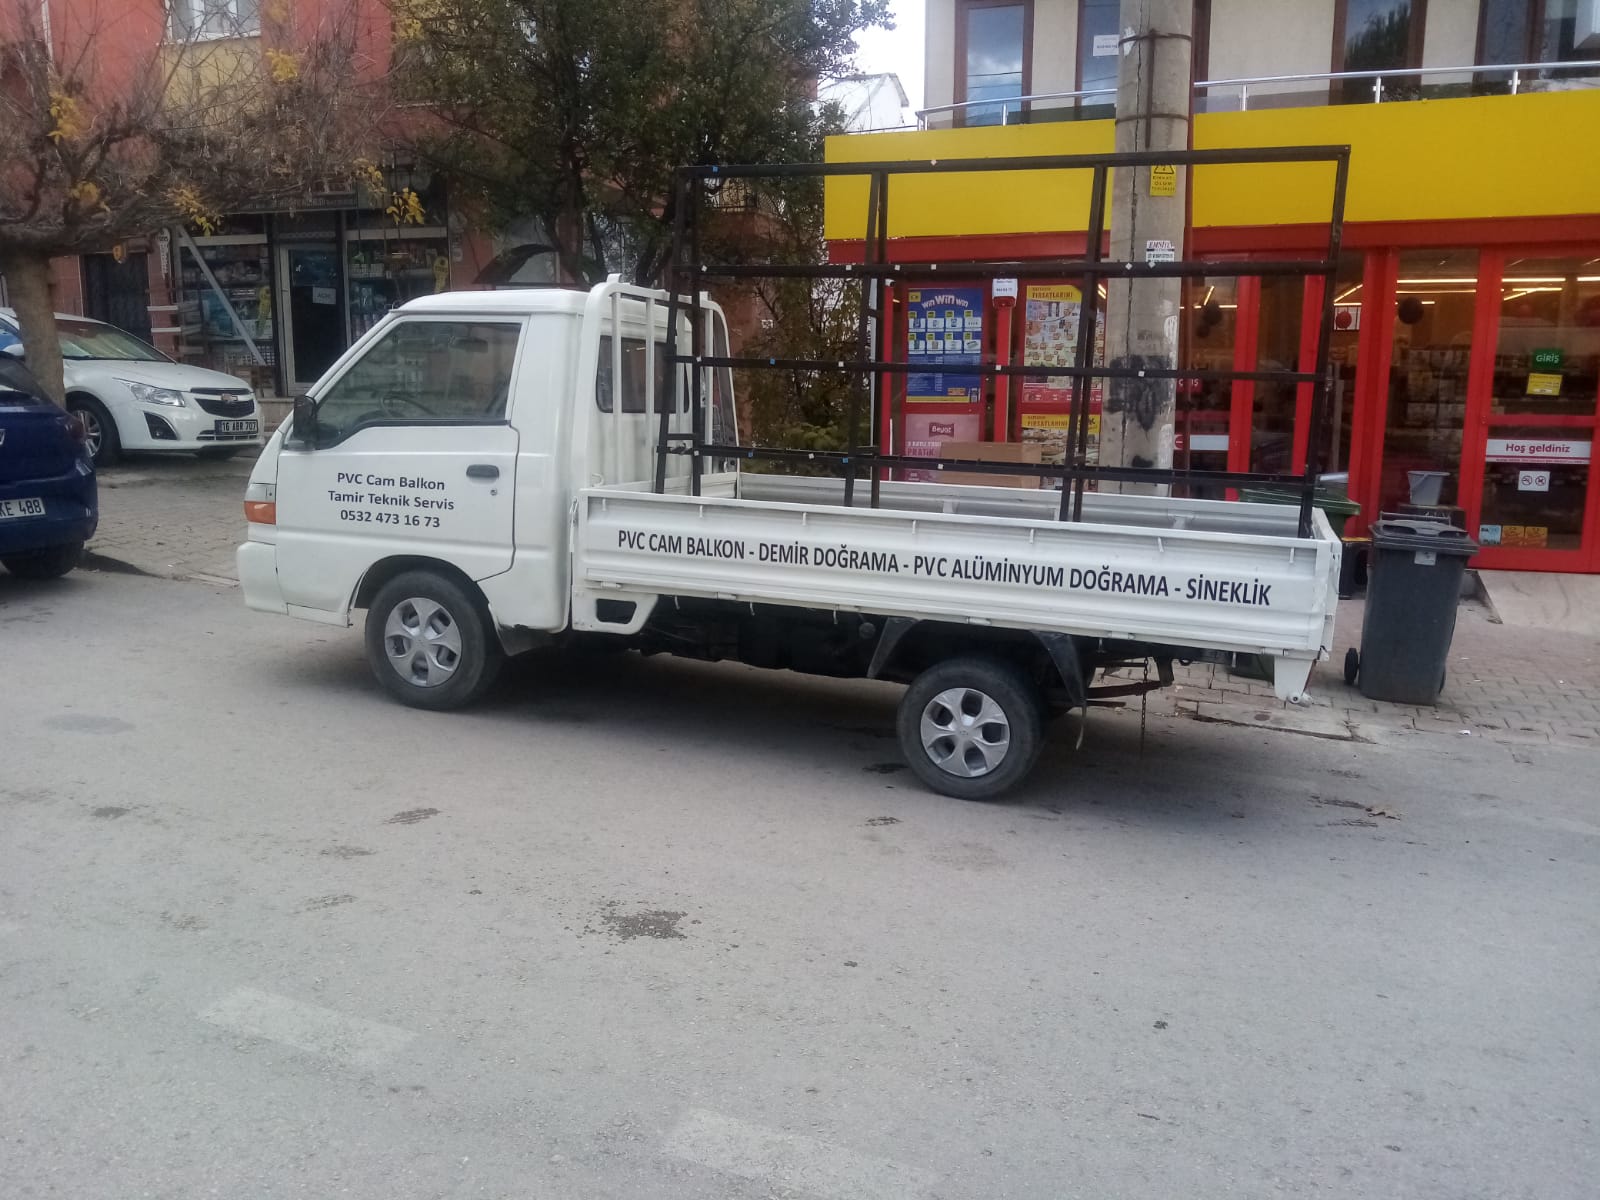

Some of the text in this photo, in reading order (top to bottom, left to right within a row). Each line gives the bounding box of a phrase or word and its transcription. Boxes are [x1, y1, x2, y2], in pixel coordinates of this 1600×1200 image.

[1535, 353, 1560, 363] GİRİŞ
[1505, 443, 1571, 455] Hoş geldiniz
[337, 472, 445, 491] PVC Cam Balkon
[18, 499, 42, 515] 488
[328, 490, 455, 511] Tamir Teknik Servis
[340, 509, 440, 528] 0532 473 16 73
[618, 530, 646, 550] PVC
[649, 533, 682, 555] CAM
[686, 537, 745, 560] BALKON
[758, 541, 809, 566] DEMİR
[813, 543, 899, 574] DOĞRAMA
[914, 555, 947, 578] PVC
[951, 556, 1065, 588] ALÜMİNYUM
[1069, 564, 1169, 597] DOĞRAMA
[1185, 574, 1272, 606] SİNEKLİK
